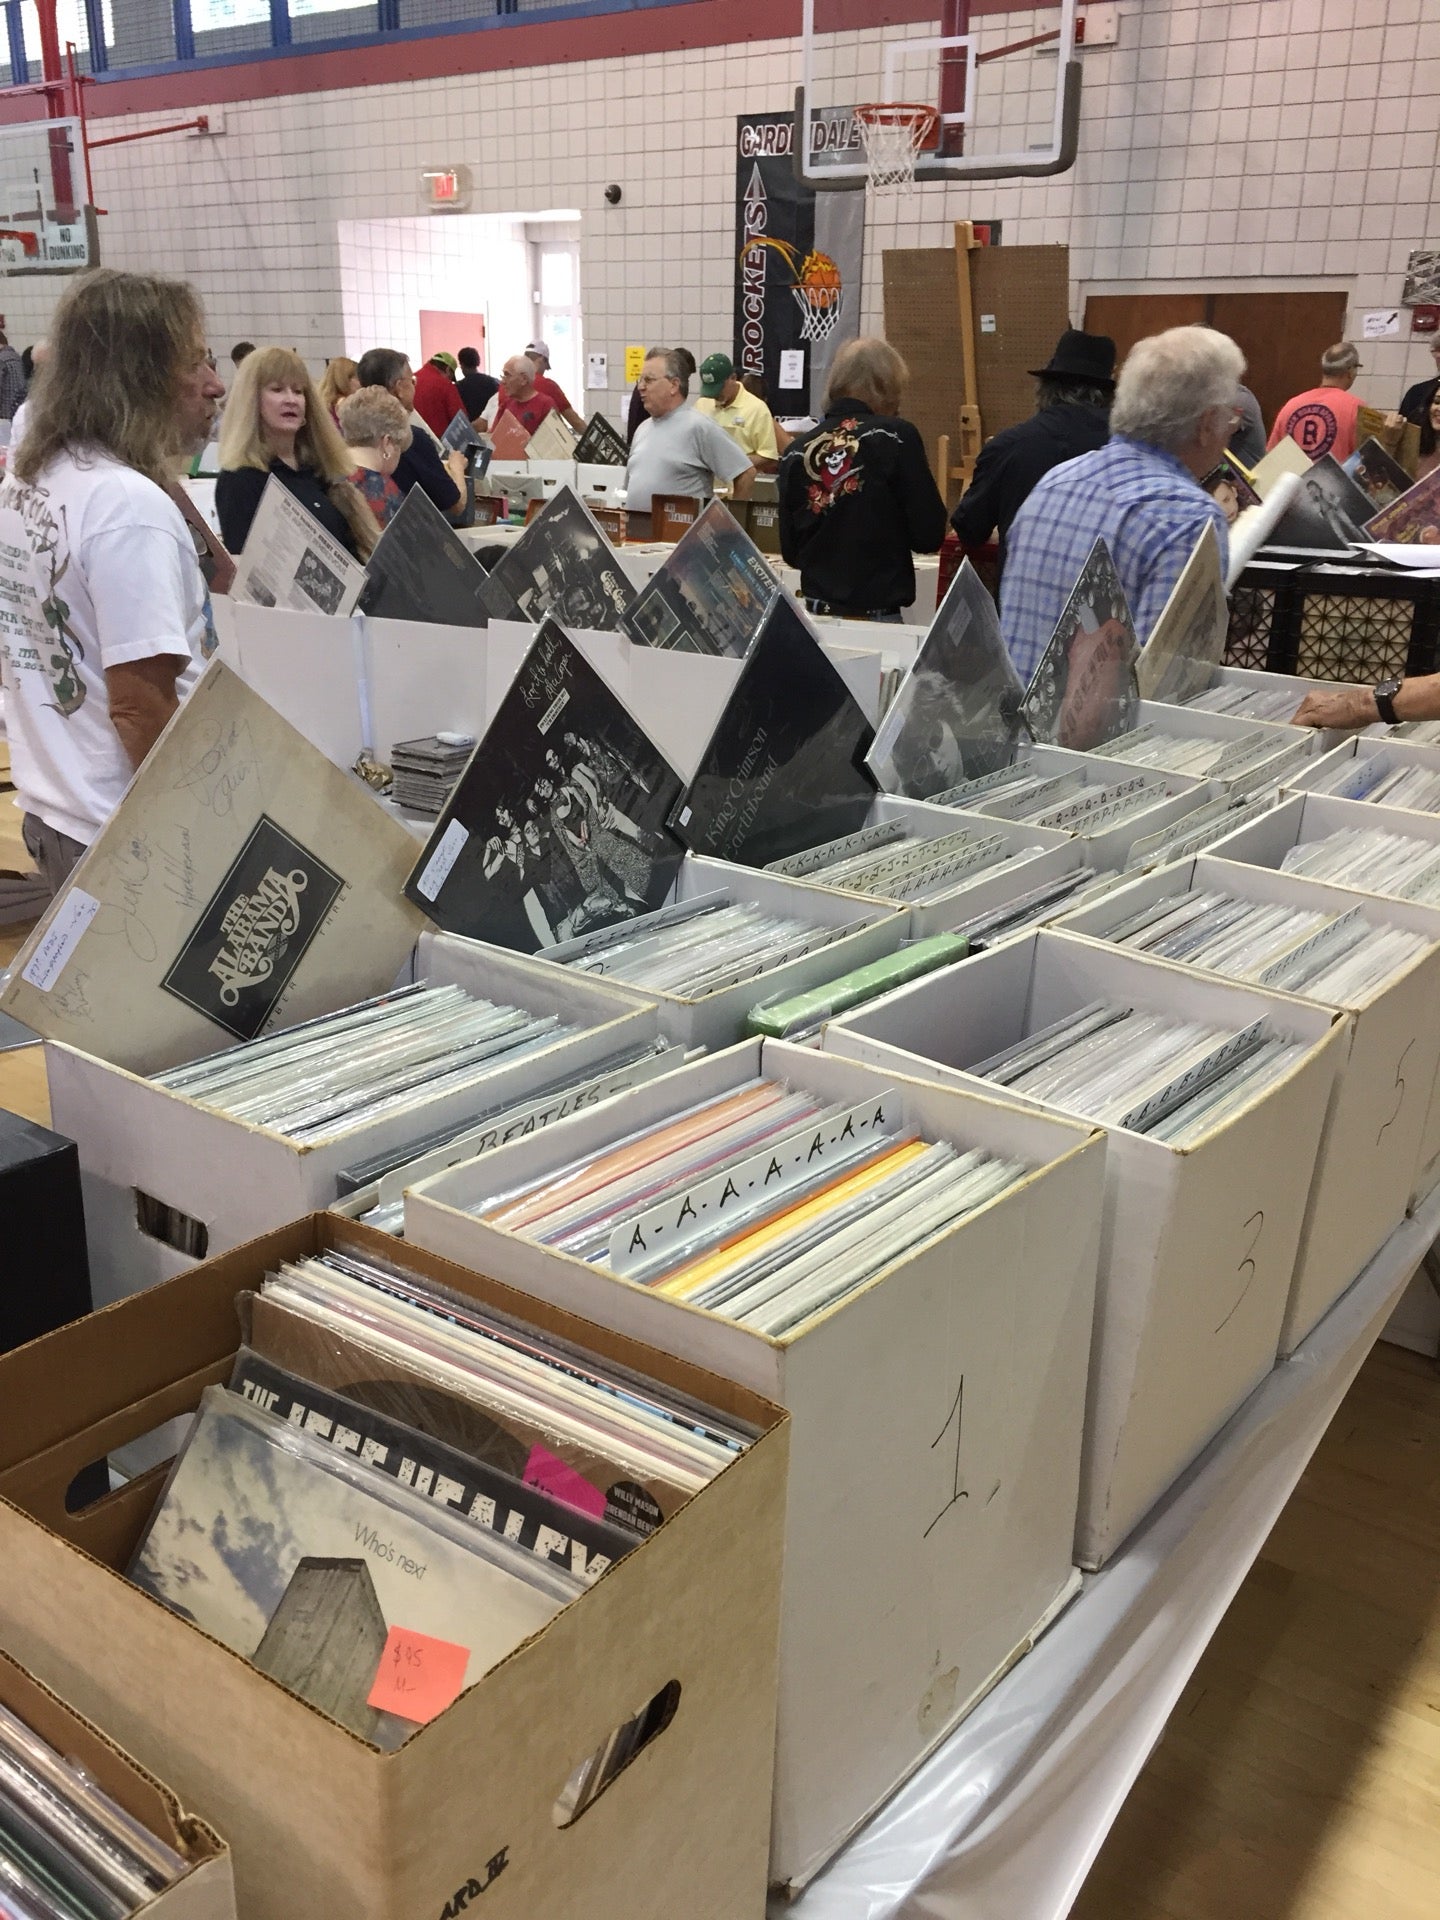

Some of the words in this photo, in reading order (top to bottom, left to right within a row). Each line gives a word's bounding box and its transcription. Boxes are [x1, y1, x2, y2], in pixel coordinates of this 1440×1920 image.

[740, 118, 862, 157] GARDDALE
[49, 244, 85, 260] DUNKING
[59, 228, 71, 242] NO
[742, 201, 767, 374] ROCKETS
[747, 556, 777, 592] EXCITER
[705, 795, 737, 847] King
[730, 727, 768, 799] Crimson
[722, 754, 779, 861] Earthbound
[208, 866, 304, 992] ALABAMA
[238, 900, 290, 975] BAND
[319, 882, 353, 937] THREE
[1214, 1211, 1264, 1334] 3
[923, 1374, 969, 1539] 1
[613, 1486, 634, 1504] WILLY
[634, 1493, 660, 1517] MASON
[355, 1522, 395, 1563] Who's
[396, 1553, 428, 1581] next
